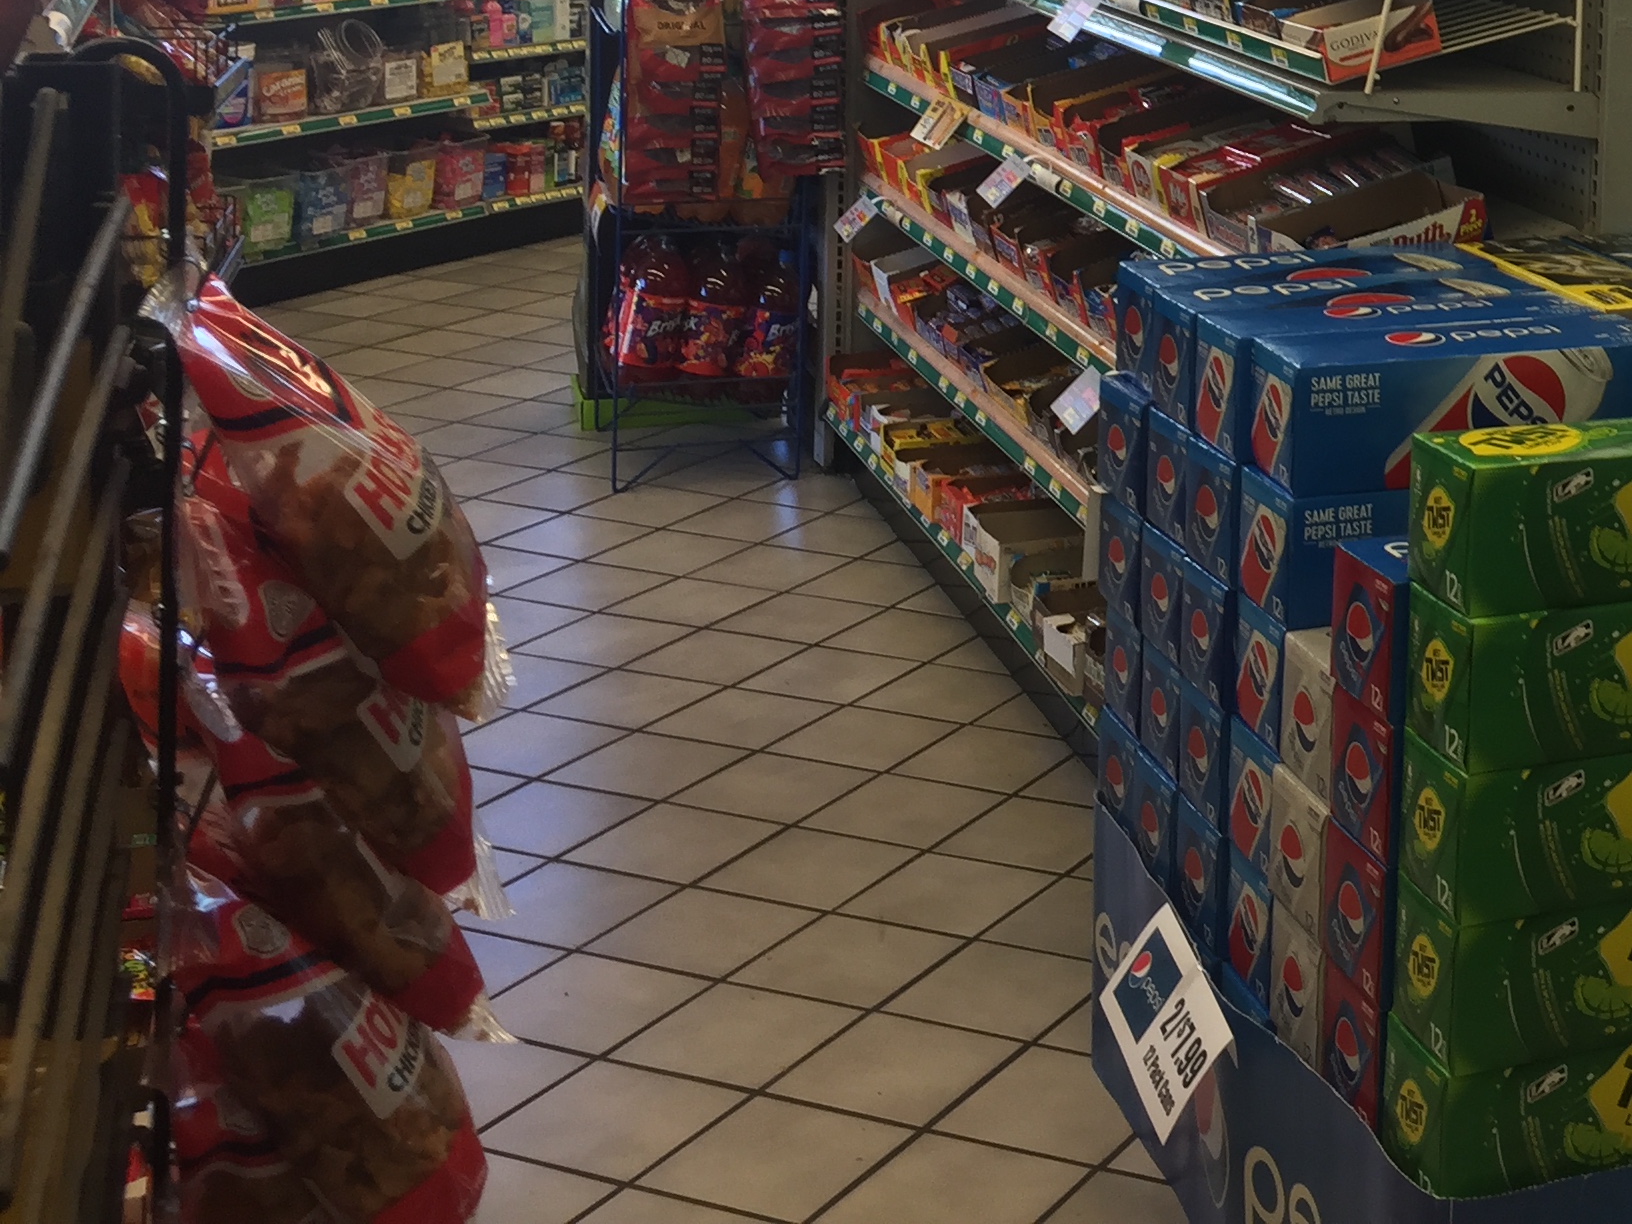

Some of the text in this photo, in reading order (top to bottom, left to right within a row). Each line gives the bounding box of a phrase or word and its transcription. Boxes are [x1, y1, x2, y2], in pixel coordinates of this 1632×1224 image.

[1158, 251, 1316, 276] pepsi
[1193, 278, 1358, 301] pepsi
[1386, 299, 1494, 316] pepsi
[1448, 322, 1562, 344] pepsi
[1311, 373, 1381, 392] SAME GREAT
[1311, 390, 1381, 408] PEPSI TASTE
[1482, 360, 1551, 427] PEPS
[1304, 504, 1373, 525] SAME GREAT
[1304, 521, 1373, 542] PEPSI TASTE
